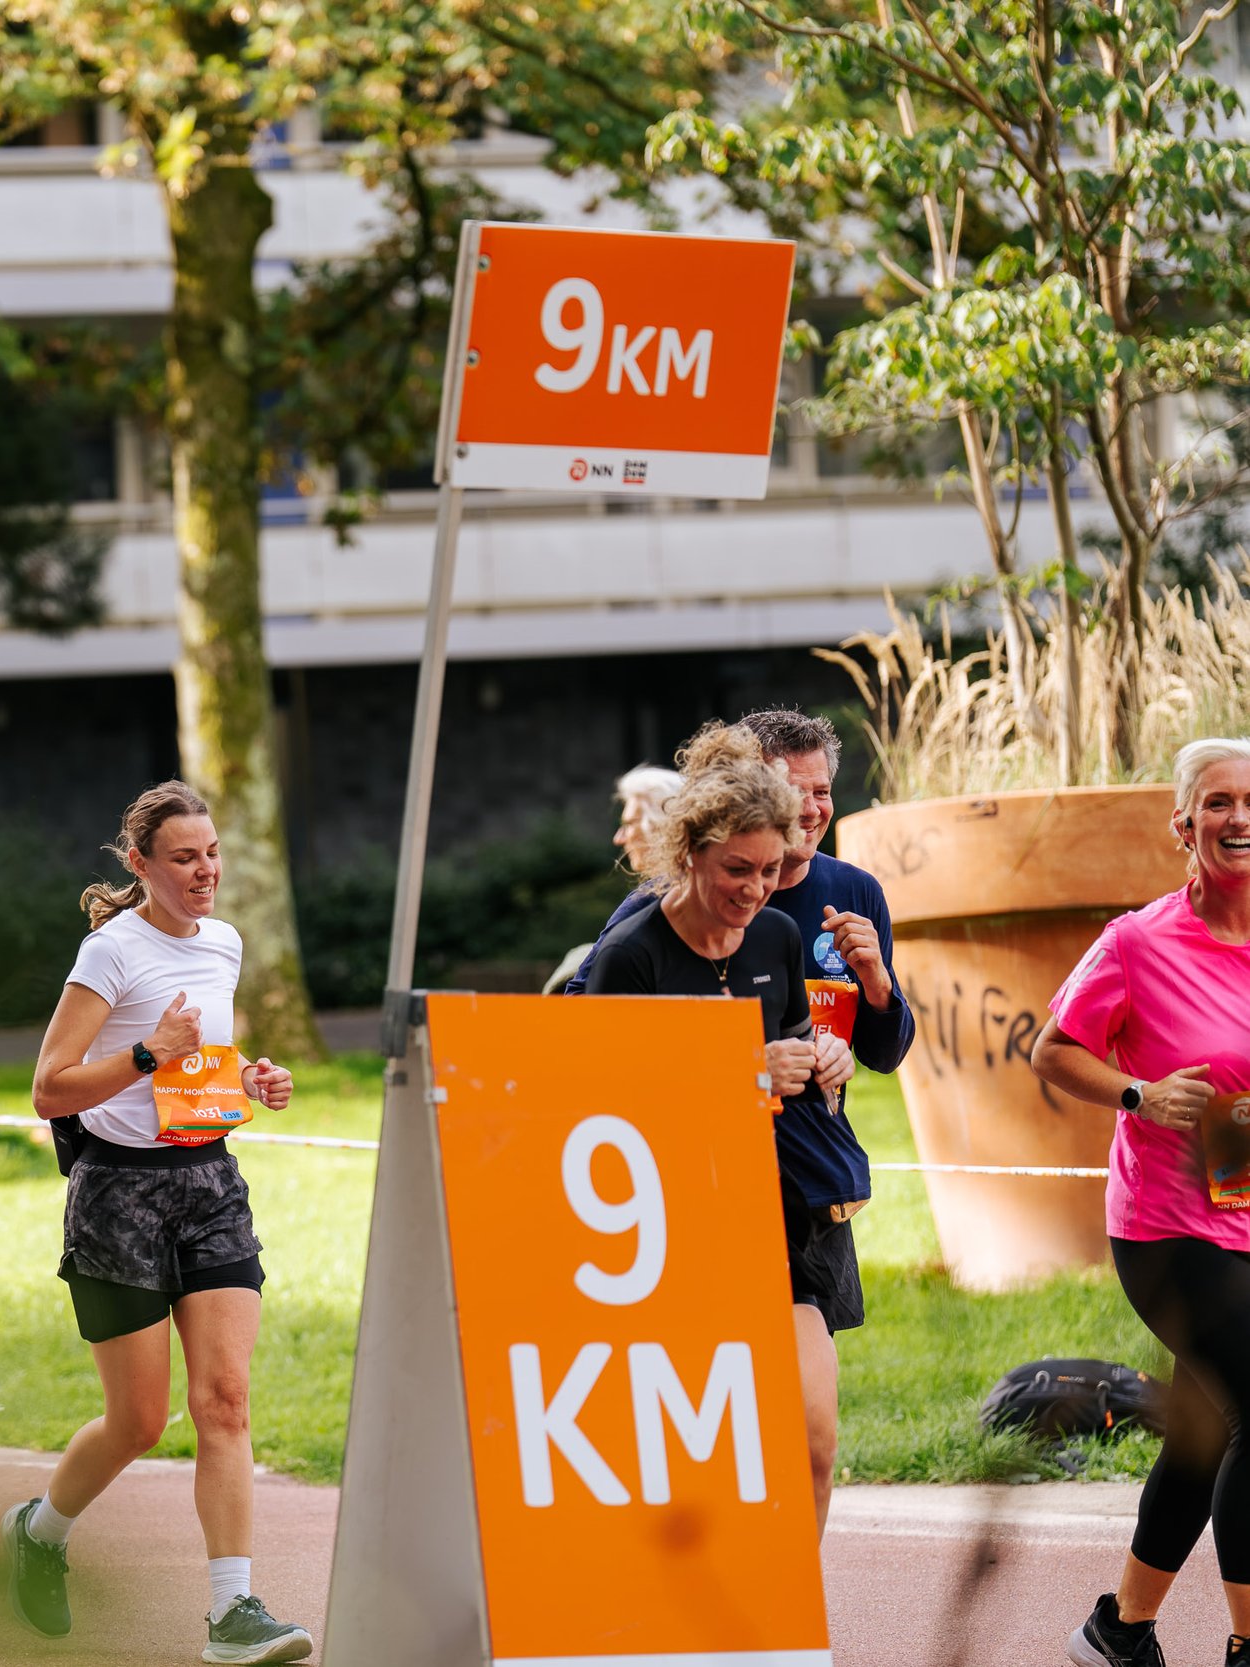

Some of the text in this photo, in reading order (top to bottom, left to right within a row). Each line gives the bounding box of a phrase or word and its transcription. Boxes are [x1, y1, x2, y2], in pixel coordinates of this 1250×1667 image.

[535, 277, 713, 399] 9 KM
[591, 464, 614, 478] NN
[810, 991, 836, 1006] NN
[205, 1056, 222, 1069] NN
[155, 1086, 182, 1095] HAPPY
[206, 1087, 243, 1095] COACHING
[191, 1106, 222, 1118] 1037
[561, 1114, 667, 1306] 9
[1231, 1200, 1250, 1209] DAM
[508, 1342, 767, 1507] KM
